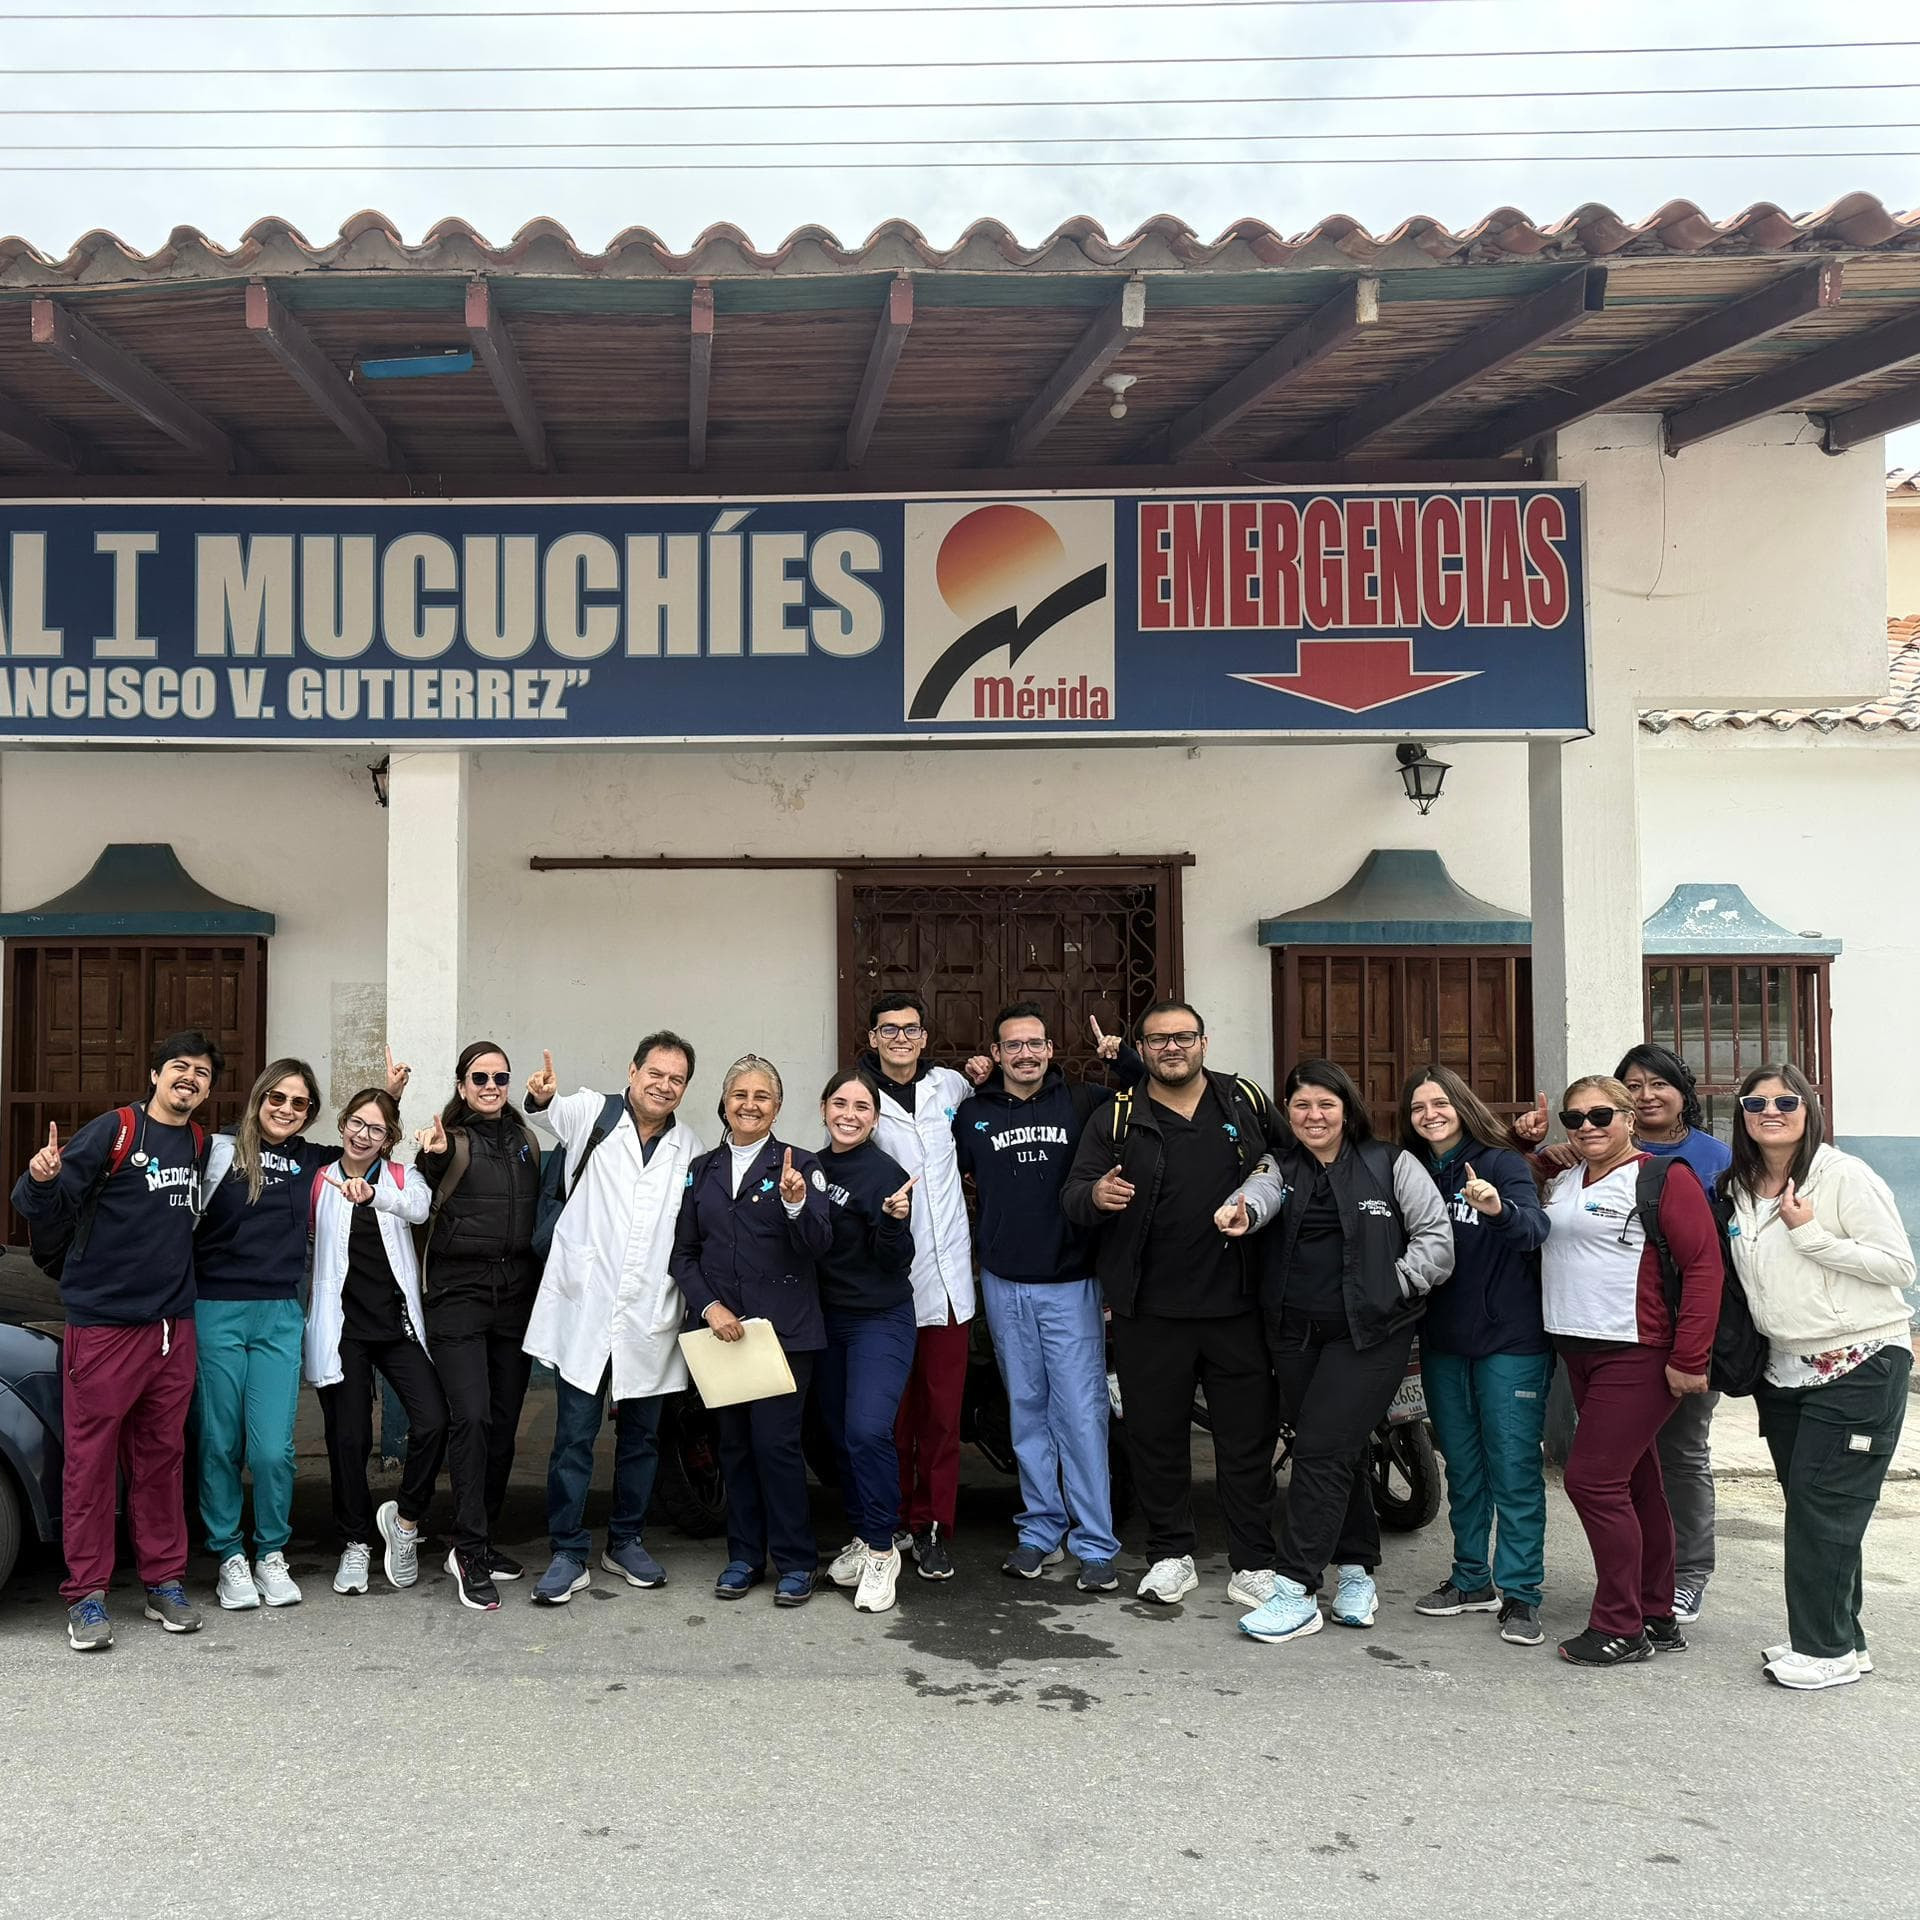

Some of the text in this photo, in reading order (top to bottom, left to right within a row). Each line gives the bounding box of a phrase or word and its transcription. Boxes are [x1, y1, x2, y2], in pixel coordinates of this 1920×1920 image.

[93, 530, 159, 660] I
[194, 507, 886, 662] MUCUCHÍES
[1137, 493, 1571, 632] EMERGENCIAS
[226, 666, 276, 720] V.
[990, 1125, 1069, 1152] MEDICINA
[1016, 1149, 1049, 1163] ULA
